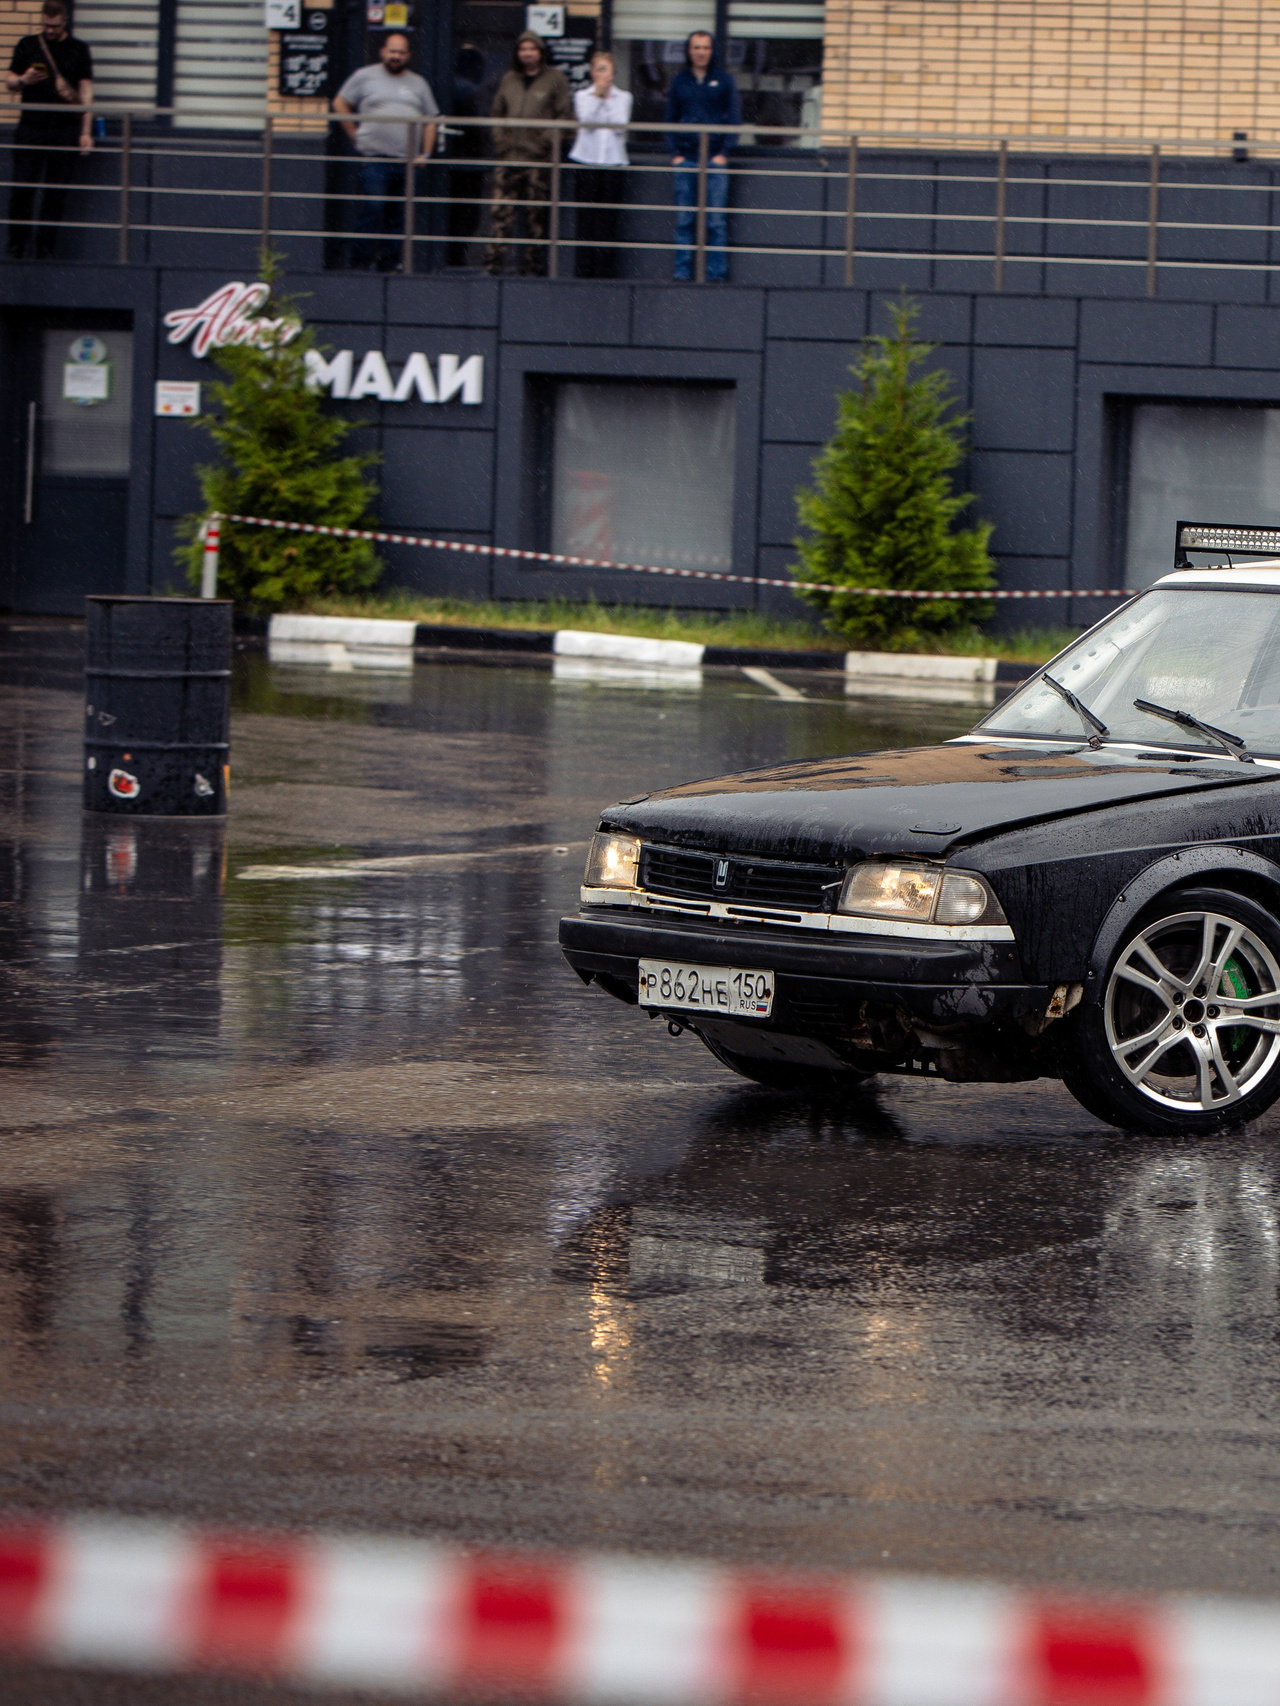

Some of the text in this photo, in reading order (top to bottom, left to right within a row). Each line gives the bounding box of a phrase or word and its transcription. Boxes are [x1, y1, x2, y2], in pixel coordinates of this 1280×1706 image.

[280, 349, 484, 404] МАЛИ
[732, 972, 768, 1000] 150
[740, 999, 756, 1011] RUS
